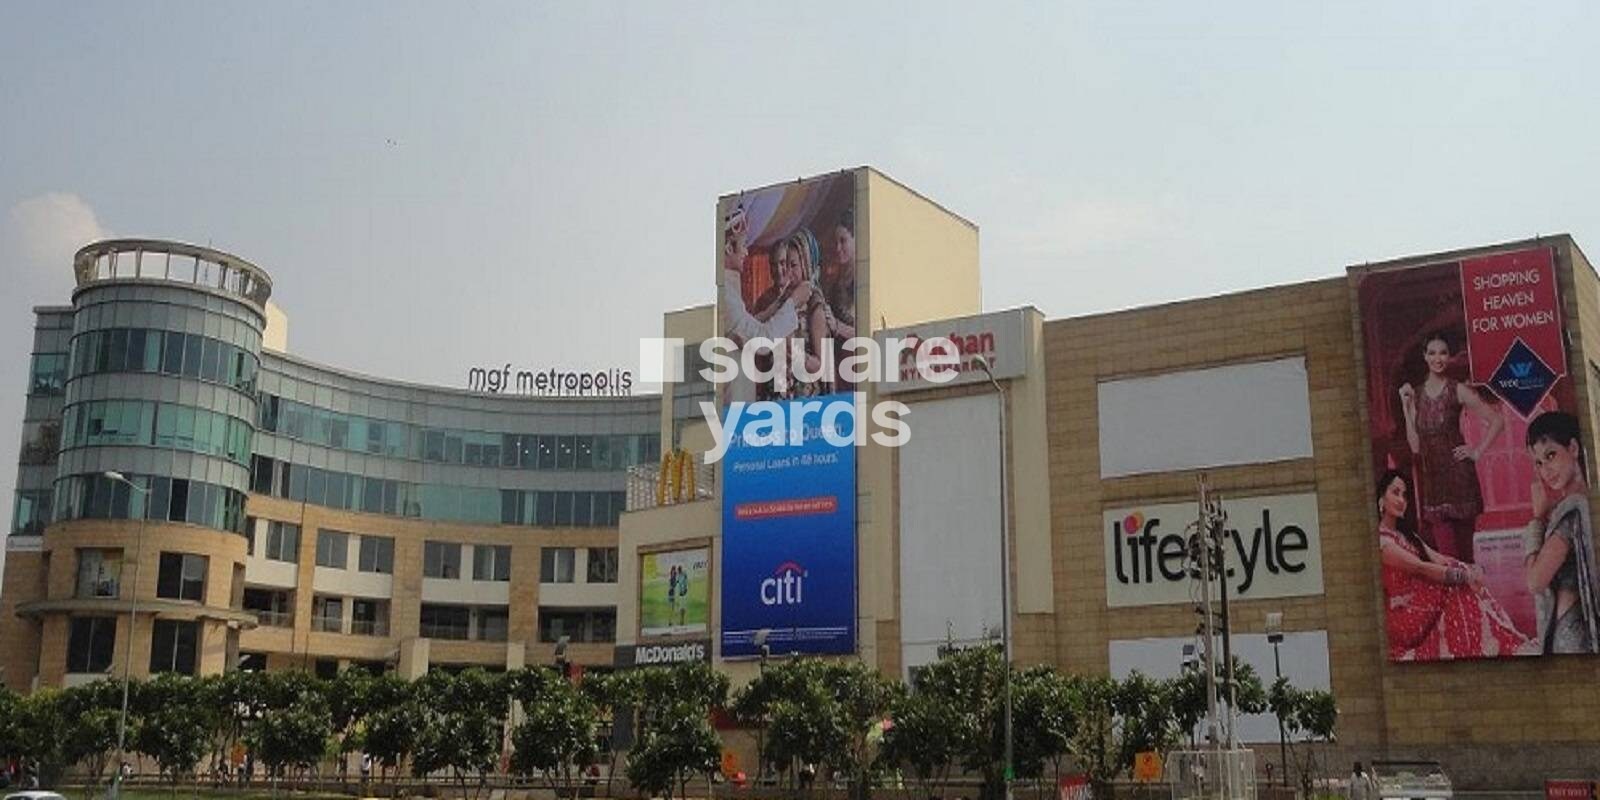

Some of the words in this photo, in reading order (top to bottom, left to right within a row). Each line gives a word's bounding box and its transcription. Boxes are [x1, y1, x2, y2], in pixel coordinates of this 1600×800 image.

[1472, 268, 1541, 290] SHOPPING
[1483, 290, 1535, 311] HEAVEN
[1472, 316, 1500, 333] FOR
[1500, 310, 1555, 330] WOMEN
[469, 363, 512, 392] mgf
[516, 367, 633, 394] metropolis
[900, 356, 997, 381] HYPERMARKT
[635, 642, 706, 665] McDonald's
